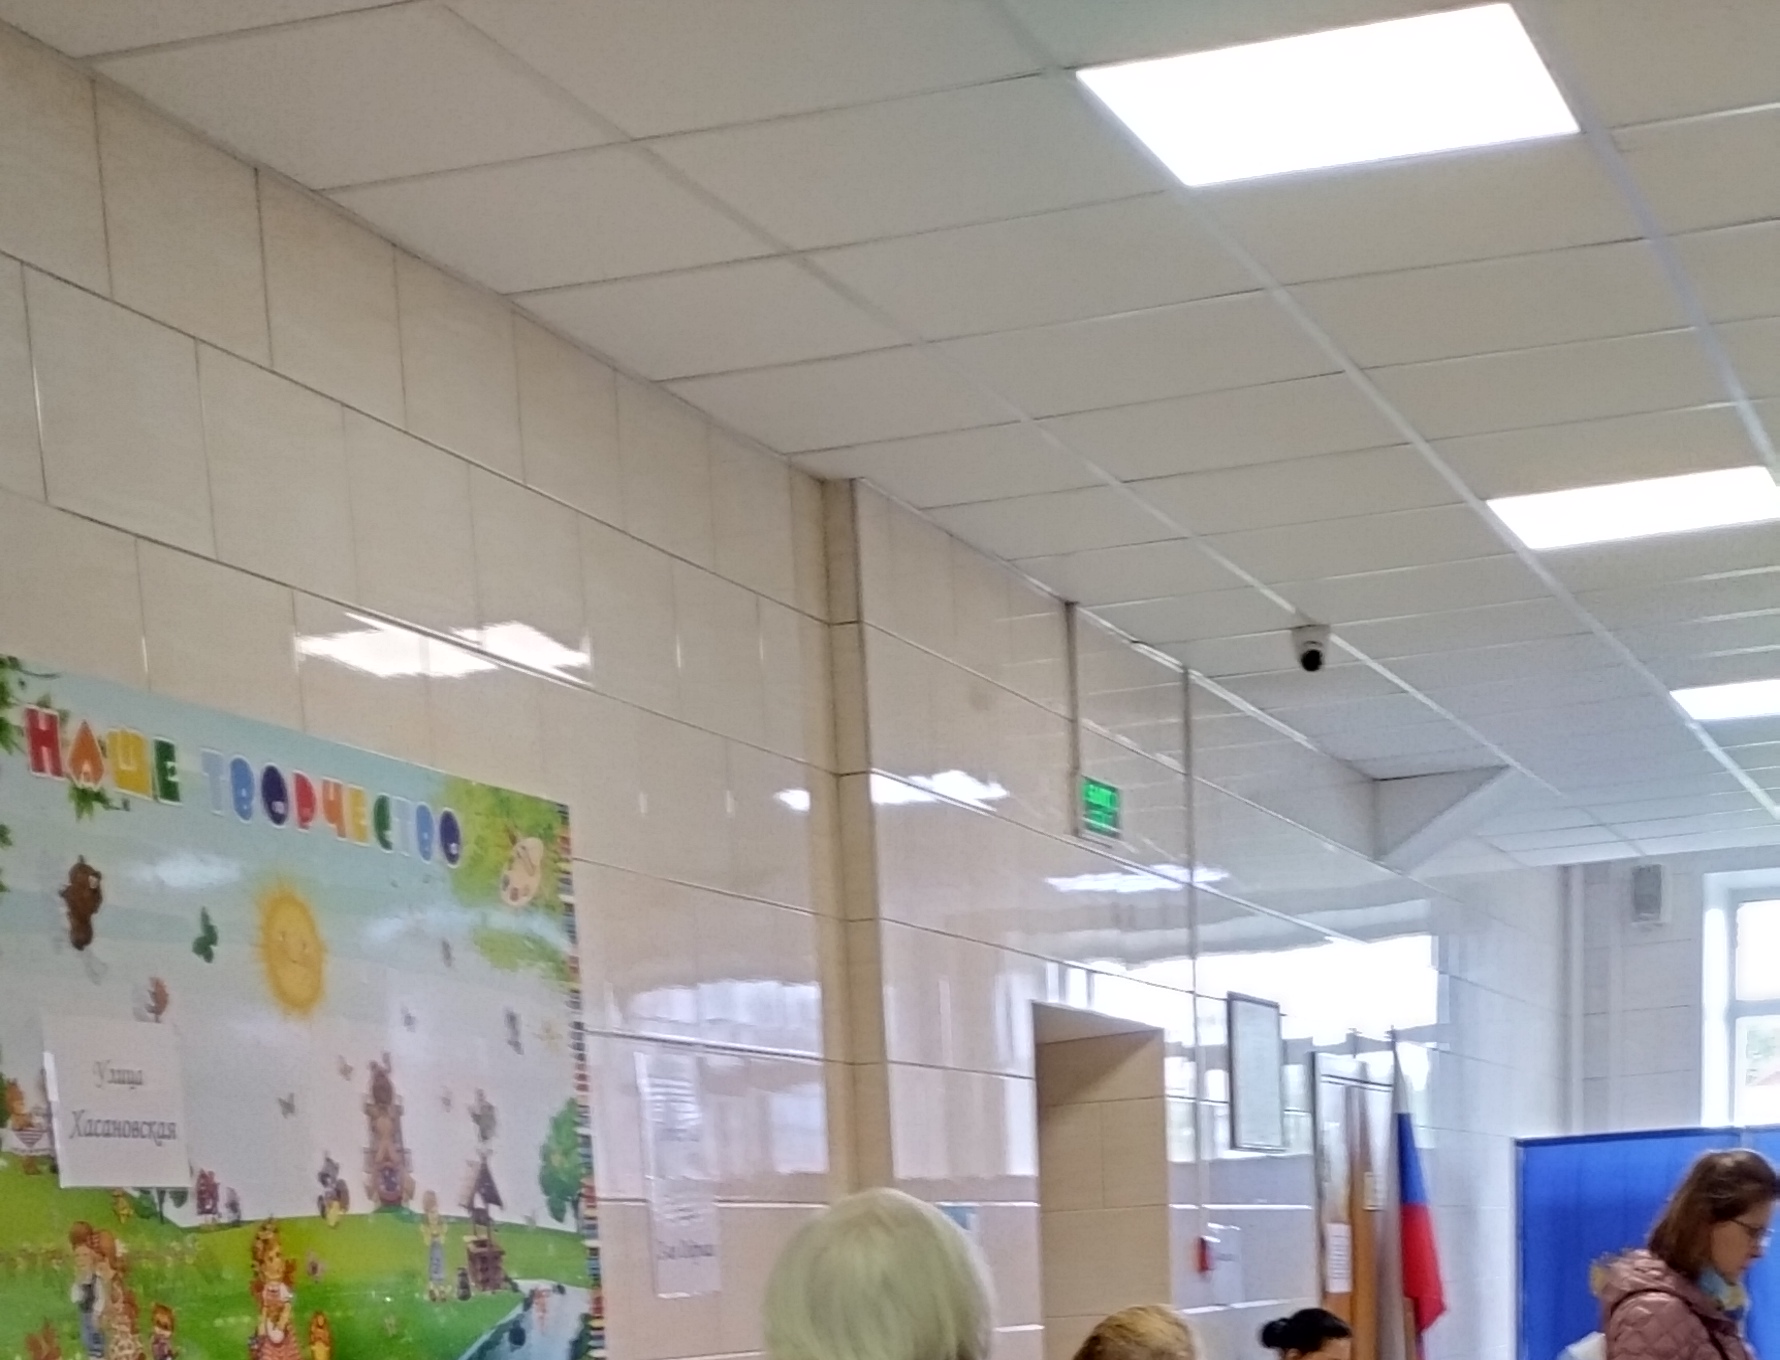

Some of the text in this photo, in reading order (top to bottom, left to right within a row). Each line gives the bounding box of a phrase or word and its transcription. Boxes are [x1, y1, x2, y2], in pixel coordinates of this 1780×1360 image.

[24, 704, 462, 868] НАШЕ ТВОРЧЕСТВО
[93, 1059, 144, 1090] Улица
[69, 1109, 177, 1147] Хасановская
